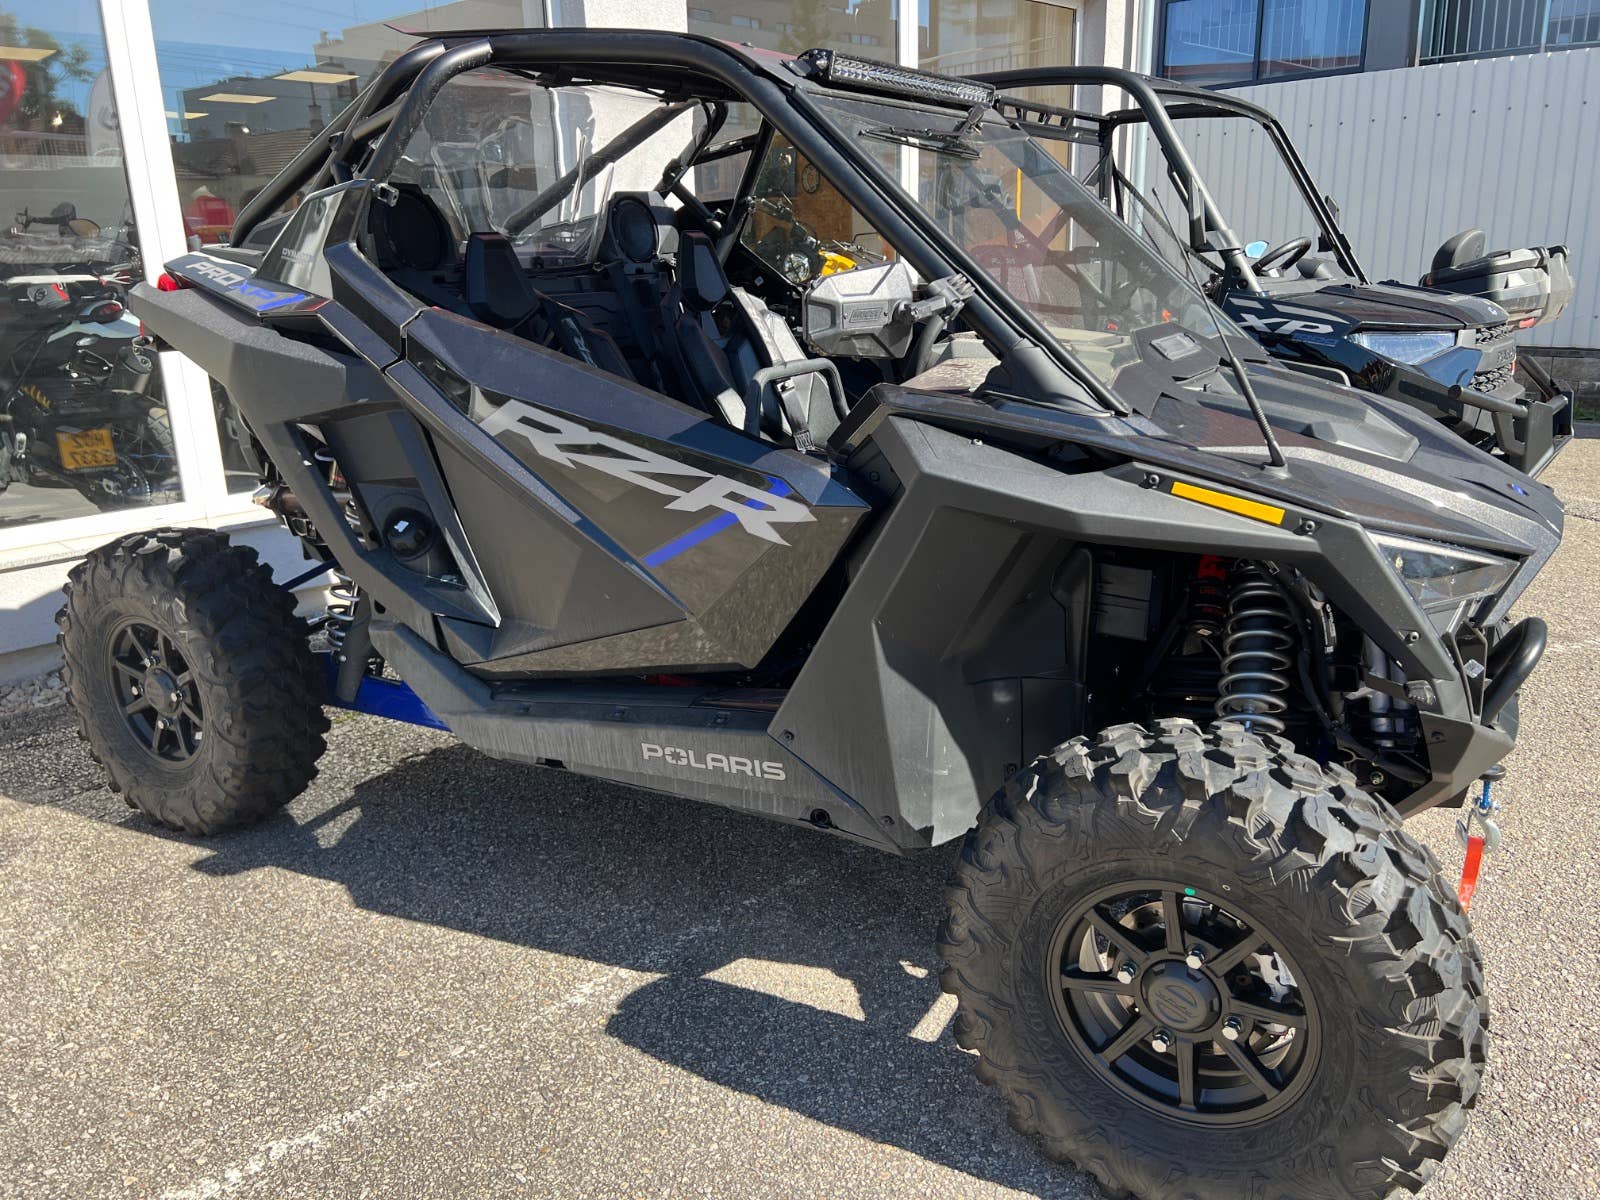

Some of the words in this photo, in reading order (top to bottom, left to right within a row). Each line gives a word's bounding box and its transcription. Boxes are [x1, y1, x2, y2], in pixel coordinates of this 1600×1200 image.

[185, 261, 247, 287] PRO
[227, 279, 277, 300] XP
[1235, 313, 1335, 335] XP
[480, 399, 818, 547] RZR
[640, 742, 786, 781] POLARIS
